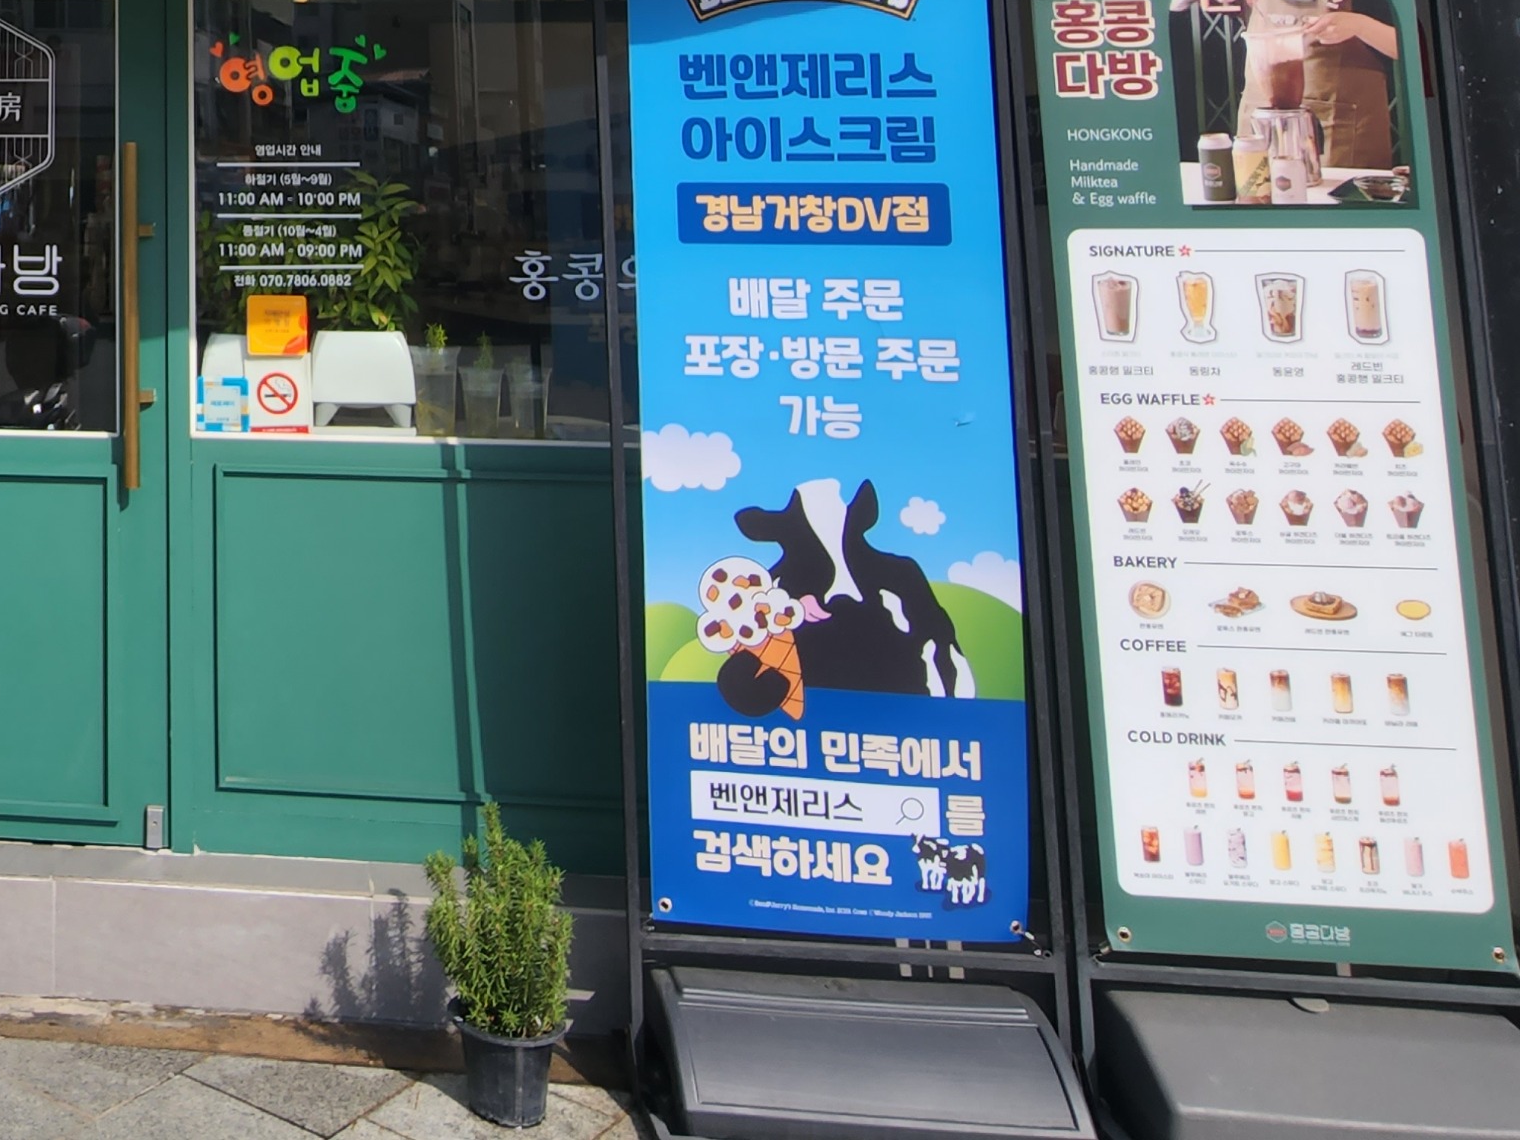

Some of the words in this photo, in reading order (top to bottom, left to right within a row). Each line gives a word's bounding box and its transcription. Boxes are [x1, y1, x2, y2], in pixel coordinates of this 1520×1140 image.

[219, 45, 368, 114] 영업중
[679, 53, 937, 101] 벤앤제리스
[1053, 51, 1163, 100] 다방
[681, 115, 937, 164] 아이스크림
[1067, 128, 1153, 142] HONGKONG
[255, 144, 297, 157] 영업시간
[300, 144, 322, 156] 안내
[1070, 159, 1138, 172] Handmade
[245, 173, 277, 186] 하절기
[280, 172, 332, 186] (5월~9월)
[1071, 176, 1119, 188] Milktea
[219, 192, 256, 206] 11:00
[259, 192, 284, 206] AM
[338, 192, 361, 206] PM
[1072, 193, 1086, 204] &
[1089, 193, 1114, 207] Egg
[1117, 192, 1156, 205] waffle
[695, 194, 930, 233] 경남거창DV점
[242, 225, 275, 237] 동절기
[219, 243, 257, 257] 11:00
[260, 243, 284, 257] AM
[297, 243, 336, 257] 09:00
[340, 243, 362, 257] PM
[1089, 245, 1175, 257] SIGNATURE
[234, 275, 256, 288] 전화
[728, 277, 811, 320] 배달
[822, 279, 904, 322] 주문
[17, 304, 58, 316] CAFE
[875, 338, 960, 382] 주문
[1351, 361, 1383, 372] 레드빈
[1123, 366, 1154, 376] 밀크티
[1372, 375, 1404, 385] 밀크티
[1100, 392, 1133, 405] EGG
[1137, 393, 1200, 406] WAFFLE
[780, 395, 862, 439] 가능
[1113, 555, 1178, 569] BAKERY
[1120, 638, 1187, 653] COFFEE
[1127, 730, 1173, 744] COLD
[1177, 732, 1226, 746] DRINK
[689, 723, 808, 770] 배달의
[820, 730, 982, 782] 민족에서
[710, 781, 863, 822] 벤앤제리스
[945, 794, 985, 837] 를
[693, 829, 893, 886] 검색하세요
[1290, 923, 1351, 941] 홍콩다방
